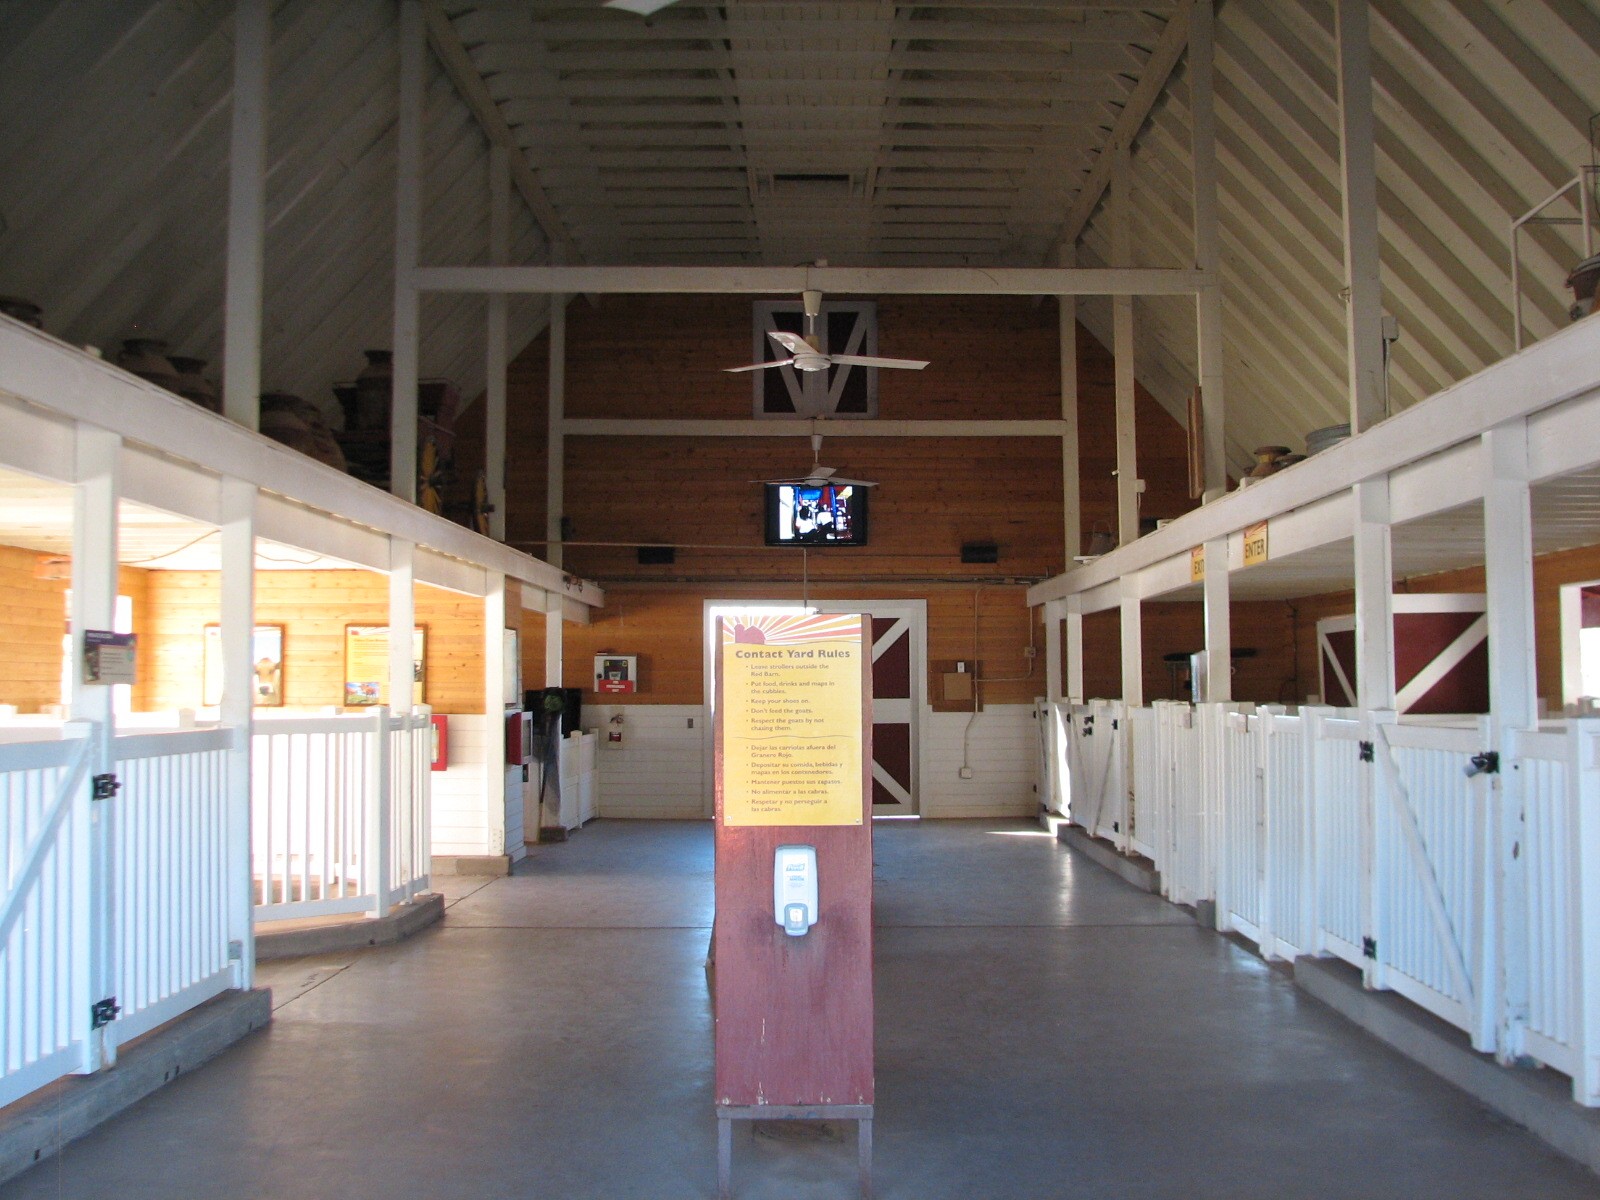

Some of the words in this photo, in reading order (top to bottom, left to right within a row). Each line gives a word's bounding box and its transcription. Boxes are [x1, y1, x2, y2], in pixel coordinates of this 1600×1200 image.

[1245, 539, 1265, 559] ENTER
[736, 650, 784, 658] Contact
[786, 650, 814, 658] Yard
[818, 650, 850, 658] Rules
[750, 724, 774, 732] chasing
[750, 762, 782, 770] Depositar
